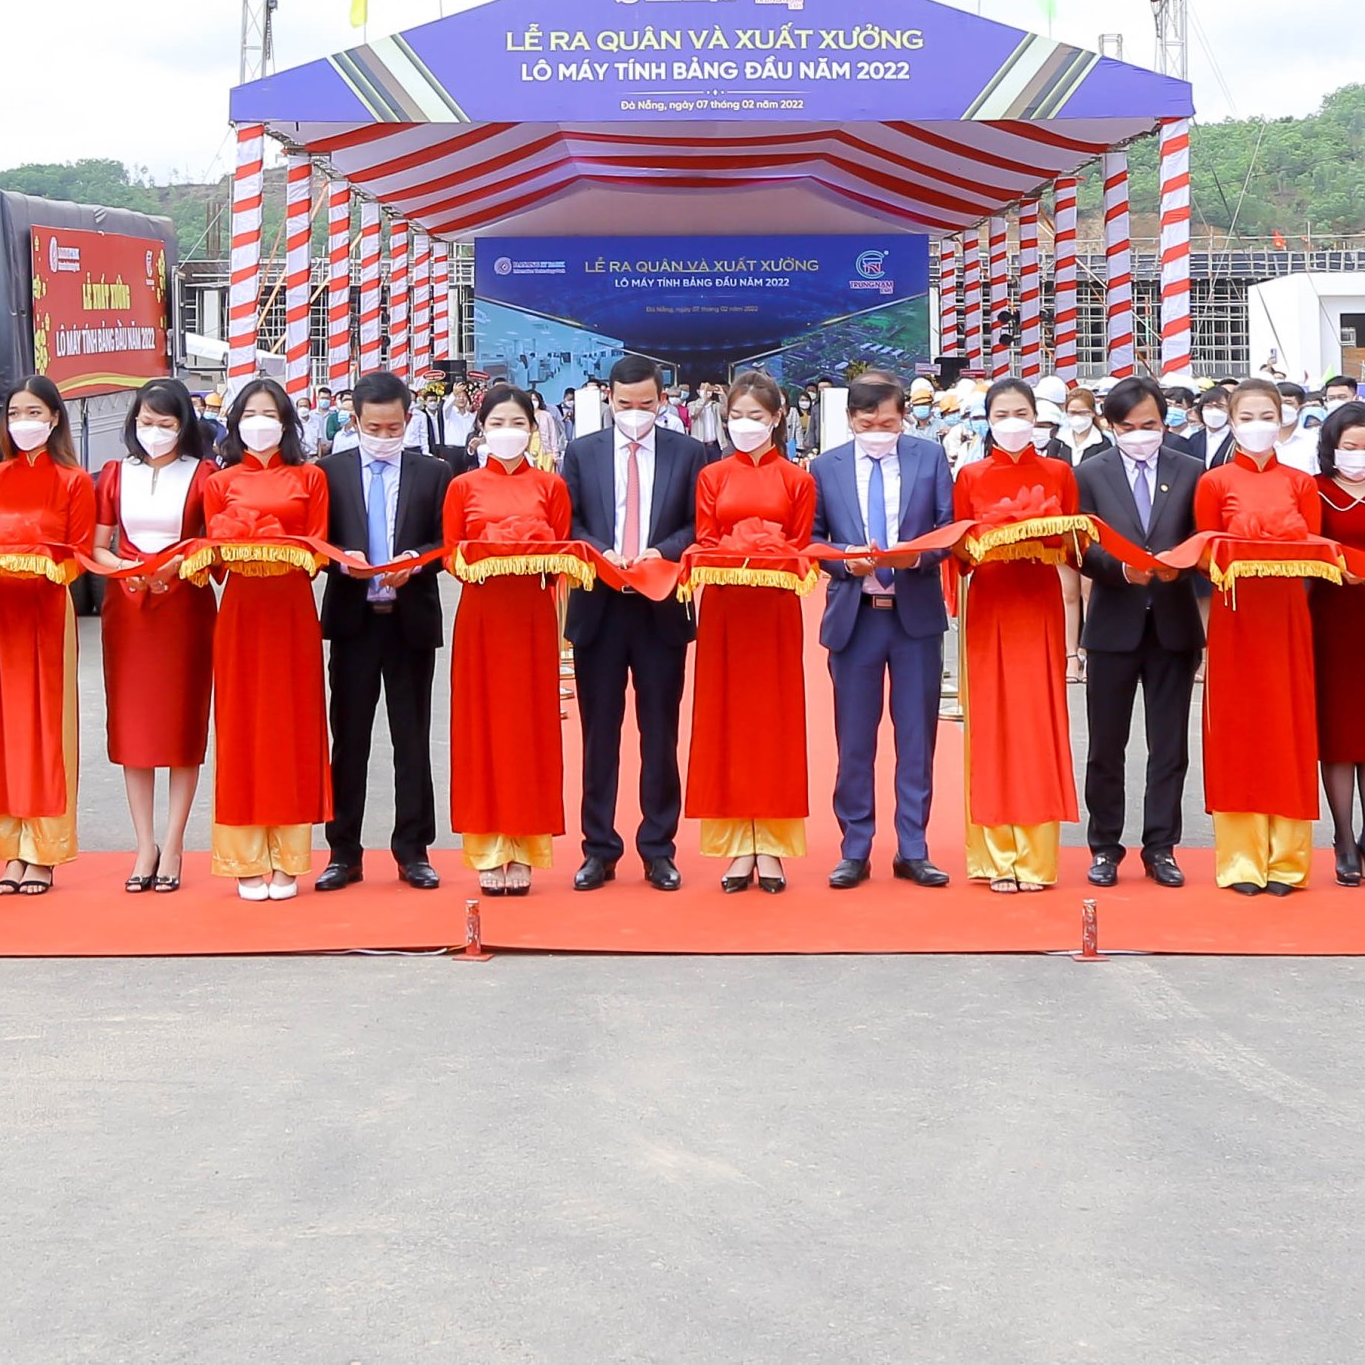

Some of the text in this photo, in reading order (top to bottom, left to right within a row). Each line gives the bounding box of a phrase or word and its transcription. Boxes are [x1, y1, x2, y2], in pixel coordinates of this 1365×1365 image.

[506, 22, 924, 53] LỄ RA QUÂN VÀ XUẤT XƯỞNG
[521, 55, 910, 81] LÔ MÁY TÍNH BẢNG ĐẦU NĂM 2022
[620, 99, 804, 111] Đà Nẵng, ngày 07 tháng 02 năm 2022
[585, 257, 606, 273] LỄ
[609, 261, 632, 273] RA
[636, 259, 683, 274] QUÂN
[687, 257, 711, 272] VÀ
[713, 257, 757, 272] XUẤT
[615, 275, 790, 288] LÔ MÁY TÍNH BẢNG ĐẦU NĂM 2022
[56, 319, 155, 357] LÔ MÁY TÍNH BẢNG ĐẦU NĂM 2022
